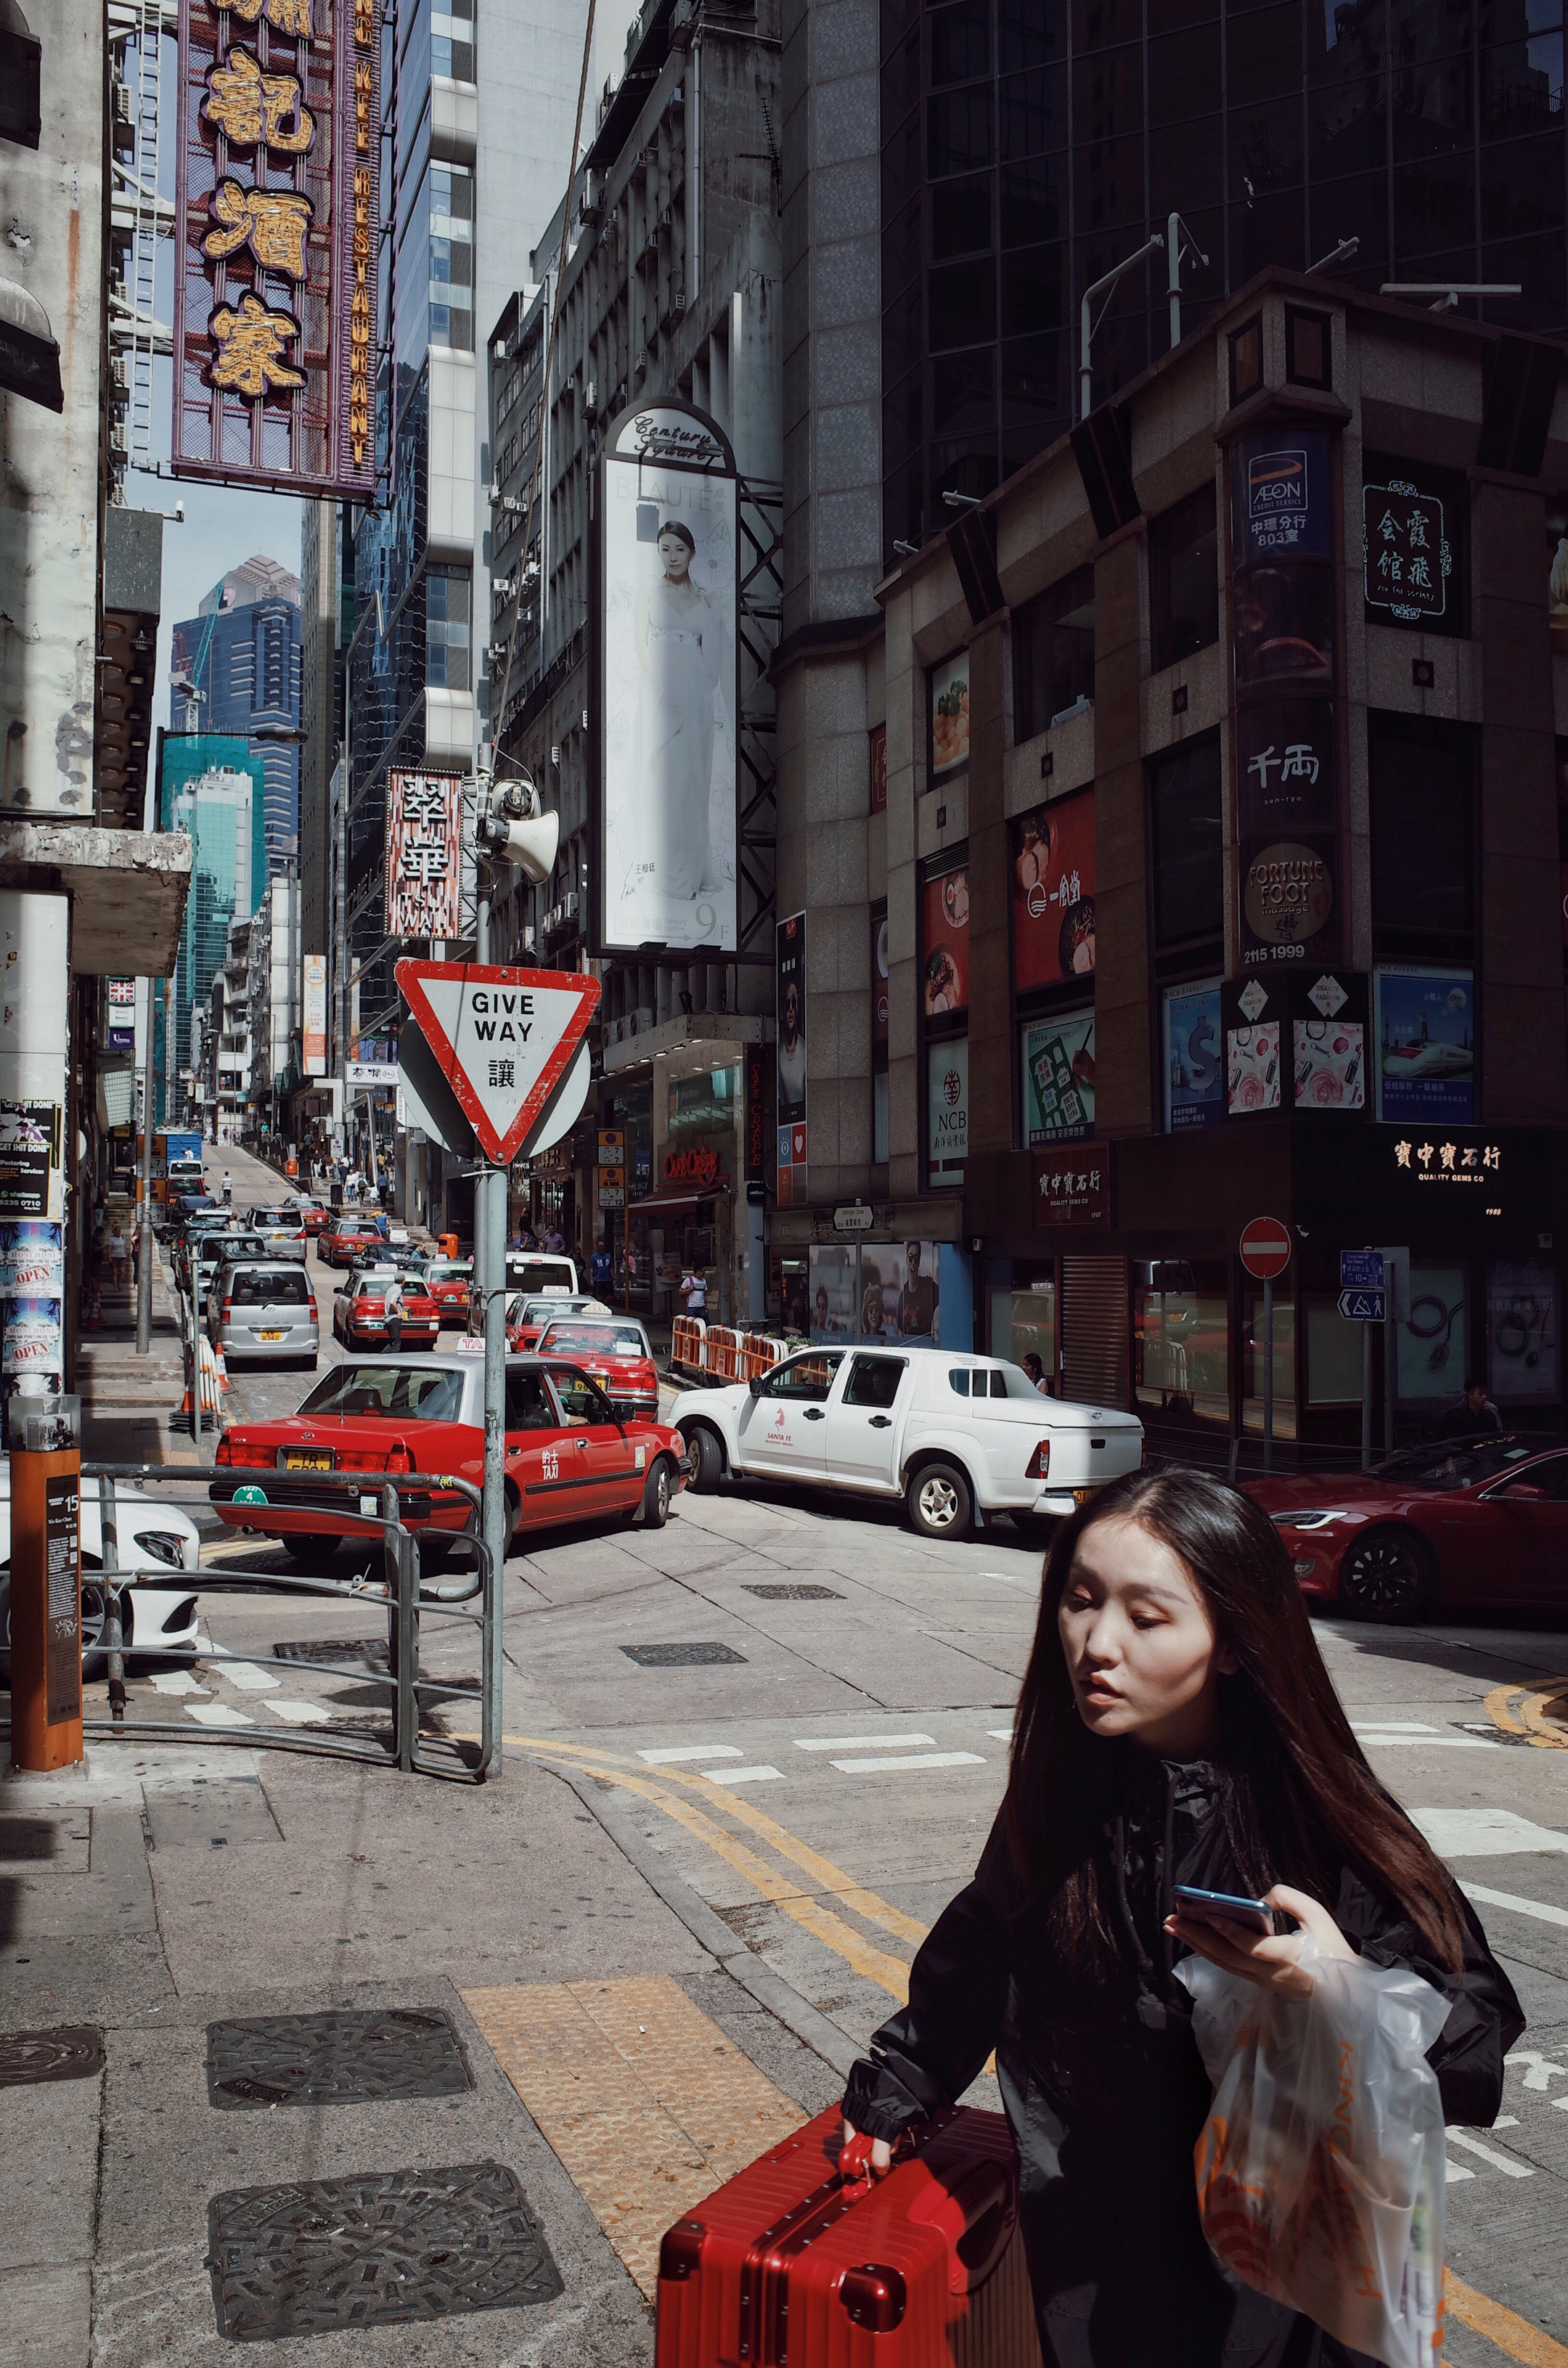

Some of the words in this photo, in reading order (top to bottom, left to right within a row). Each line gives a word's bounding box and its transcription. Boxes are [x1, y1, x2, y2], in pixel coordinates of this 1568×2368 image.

[354, 61, 372, 151] KEE
[350, 167, 372, 465] RESTAURANT
[634, 416, 711, 449] Century
[1253, 502, 1275, 512] CREDIT
[1251, 515, 1307, 535] 中環分行
[1258, 529, 1299, 546] 803室
[1264, 796, 1302, 805] sen-ryo
[401, 778, 449, 888] 翠華
[1250, 861, 1324, 886] FORTUNE
[1050, 870, 1080, 907] 一風堂
[1261, 882, 1310, 905] FOOT
[1262, 905, 1310, 915] massage
[618, 916, 662, 931] 世紀廣場
[1244, 948, 1267, 964] 2115
[1270, 945, 1305, 959] 1999
[1244, 989, 1261, 997] BEAUTY
[1244, 997, 1262, 1006] FASHION
[471, 992, 535, 1016] GIVE
[474, 1021, 534, 1042] WAY
[488, 1059, 516, 1089] 讓
[939, 1111, 967, 1132] NCB
[12, 1143, 27, 1152] SHIT
[934, 1133, 968, 1150] 南洋商業銀
[1395, 1140, 1501, 1170] 寶中寶石行
[1040, 1169, 1101, 1197] 寶中寶石行
[16, 1267, 49, 1284] OPEN
[15, 1343, 48, 1360] OPEN
[462, 1339, 483, 1349] TA
[577, 1382, 603, 1391] 983
[301, 1453, 319, 1466] TR
[542, 1449, 559, 1464] 的士
[542, 1464, 559, 1480] TAXI
[65, 1495, 79, 1512] 15
[245, 1492, 253, 1501] 4
